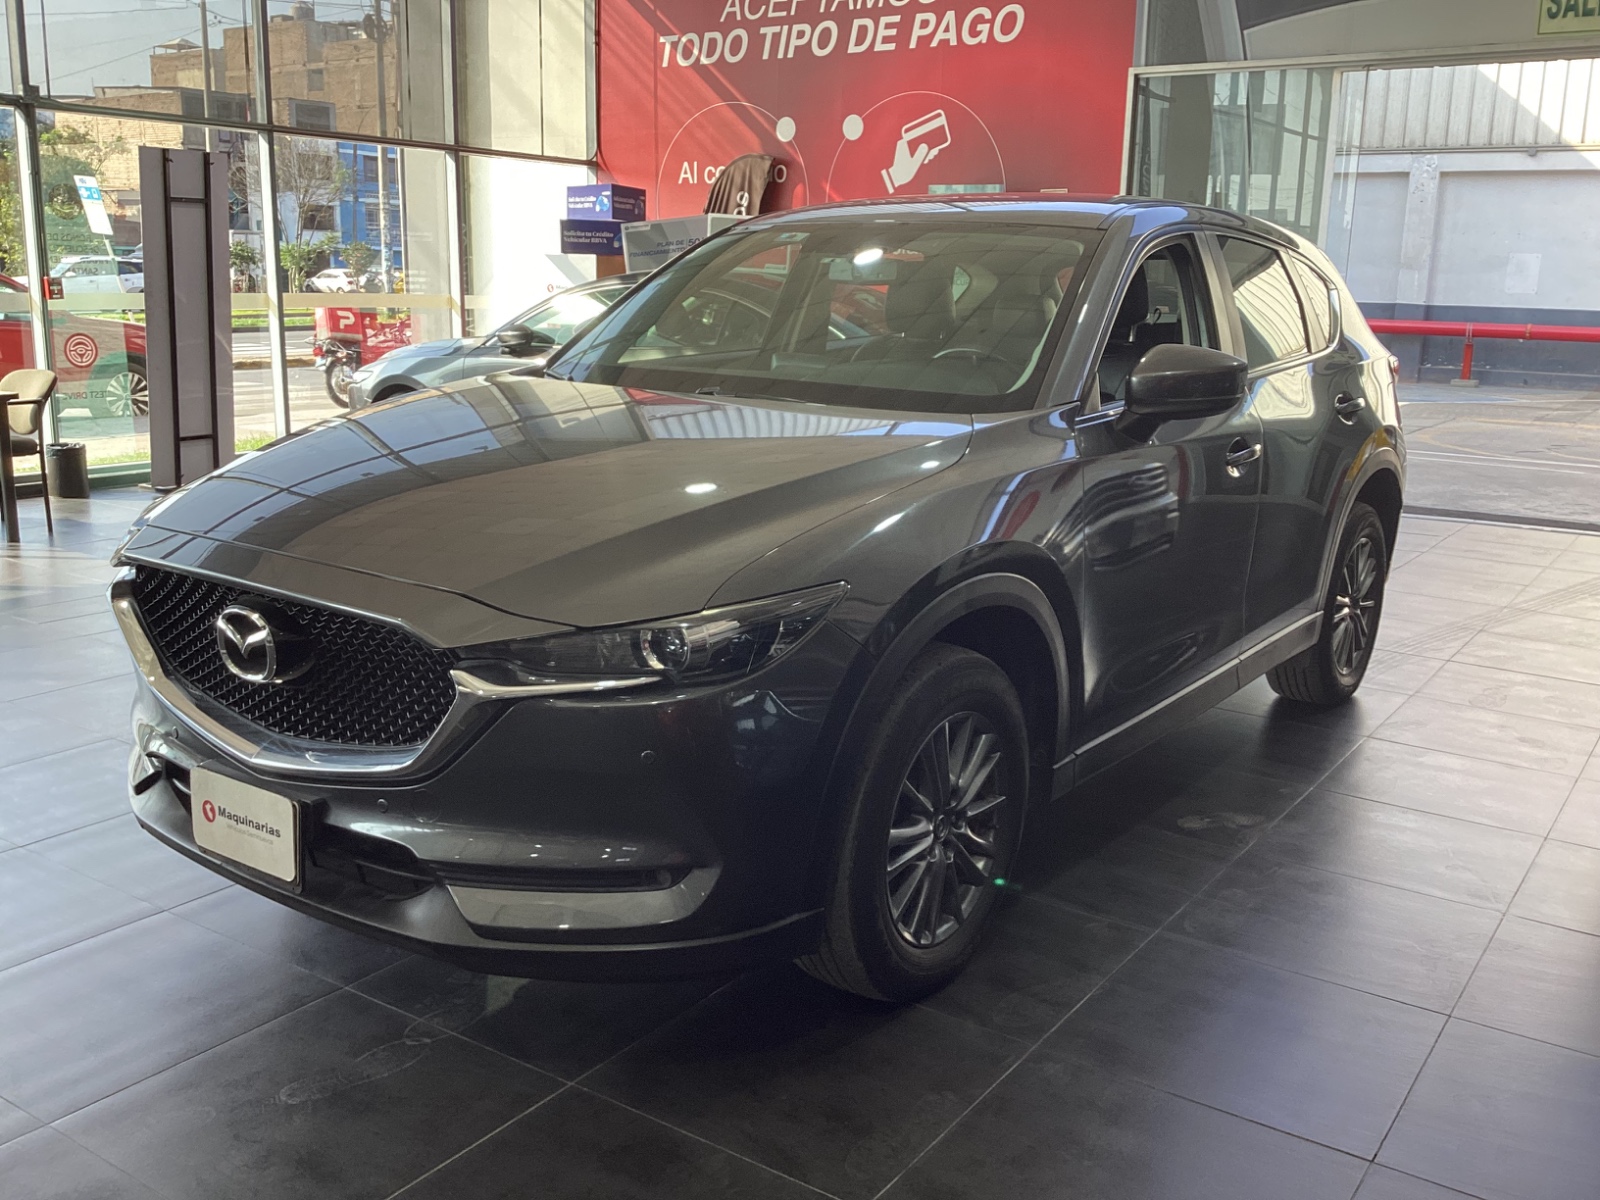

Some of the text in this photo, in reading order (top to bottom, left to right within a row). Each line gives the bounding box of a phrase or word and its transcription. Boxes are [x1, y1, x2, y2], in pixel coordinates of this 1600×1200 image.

[659, 28, 748, 68] TODO
[759, 20, 838, 60] TIPO
[847, 15, 901, 54] DE
[909, 4, 1025, 49] PAGO
[678, 161, 698, 184] Al
[217, 806, 281, 838] Maquinarias
